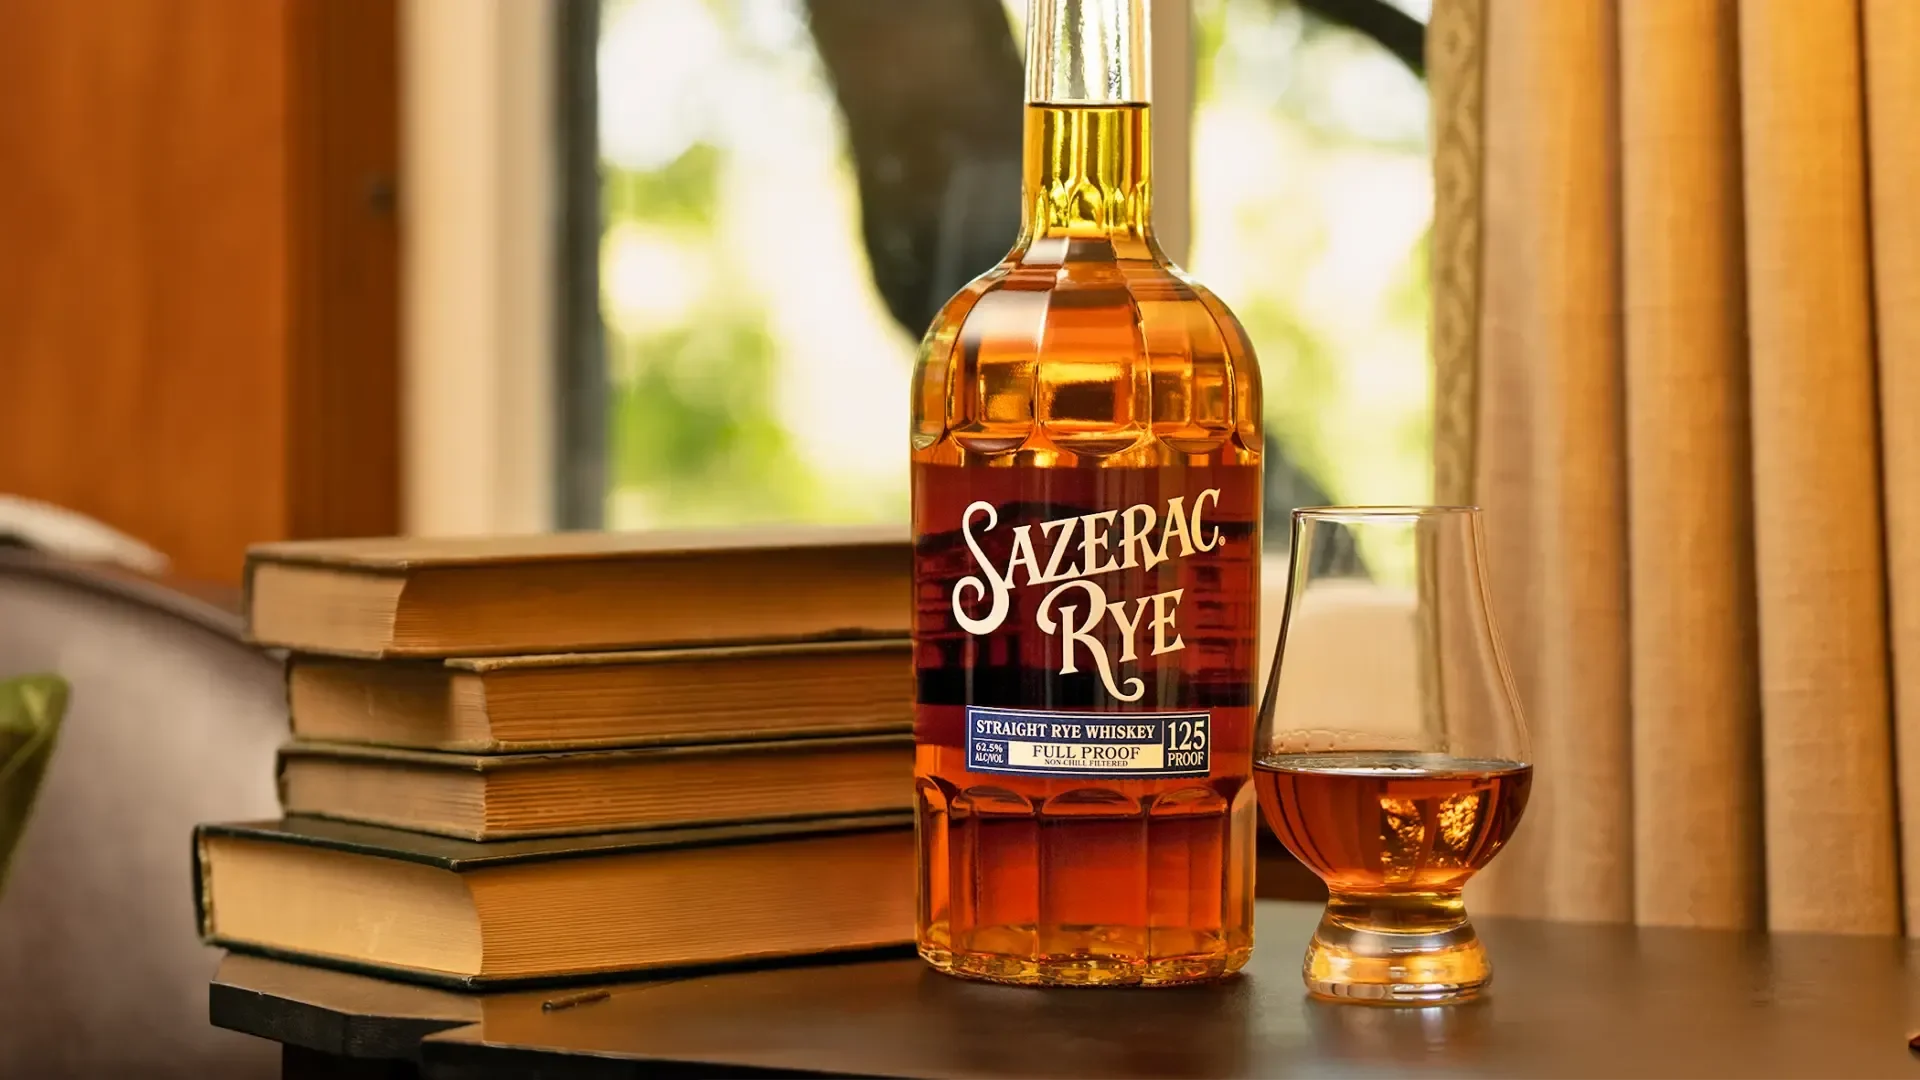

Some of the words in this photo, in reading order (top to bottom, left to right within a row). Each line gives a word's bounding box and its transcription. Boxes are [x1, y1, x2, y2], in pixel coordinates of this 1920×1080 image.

[1036, 580, 1186, 702] RYE
[976, 719, 1047, 738] STRAIGHT
[1051, 724, 1081, 739] RYE
[1085, 724, 1156, 740] WHISKEY
[1168, 720, 1206, 751] 125
[975, 742, 1003, 753] 62.5%
[1032, 745, 1076, 759] FULL
[1081, 746, 1141, 760] PROOF
[975, 752, 1004, 764] ALC/VOL
[1168, 751, 1205, 767] PROOF
